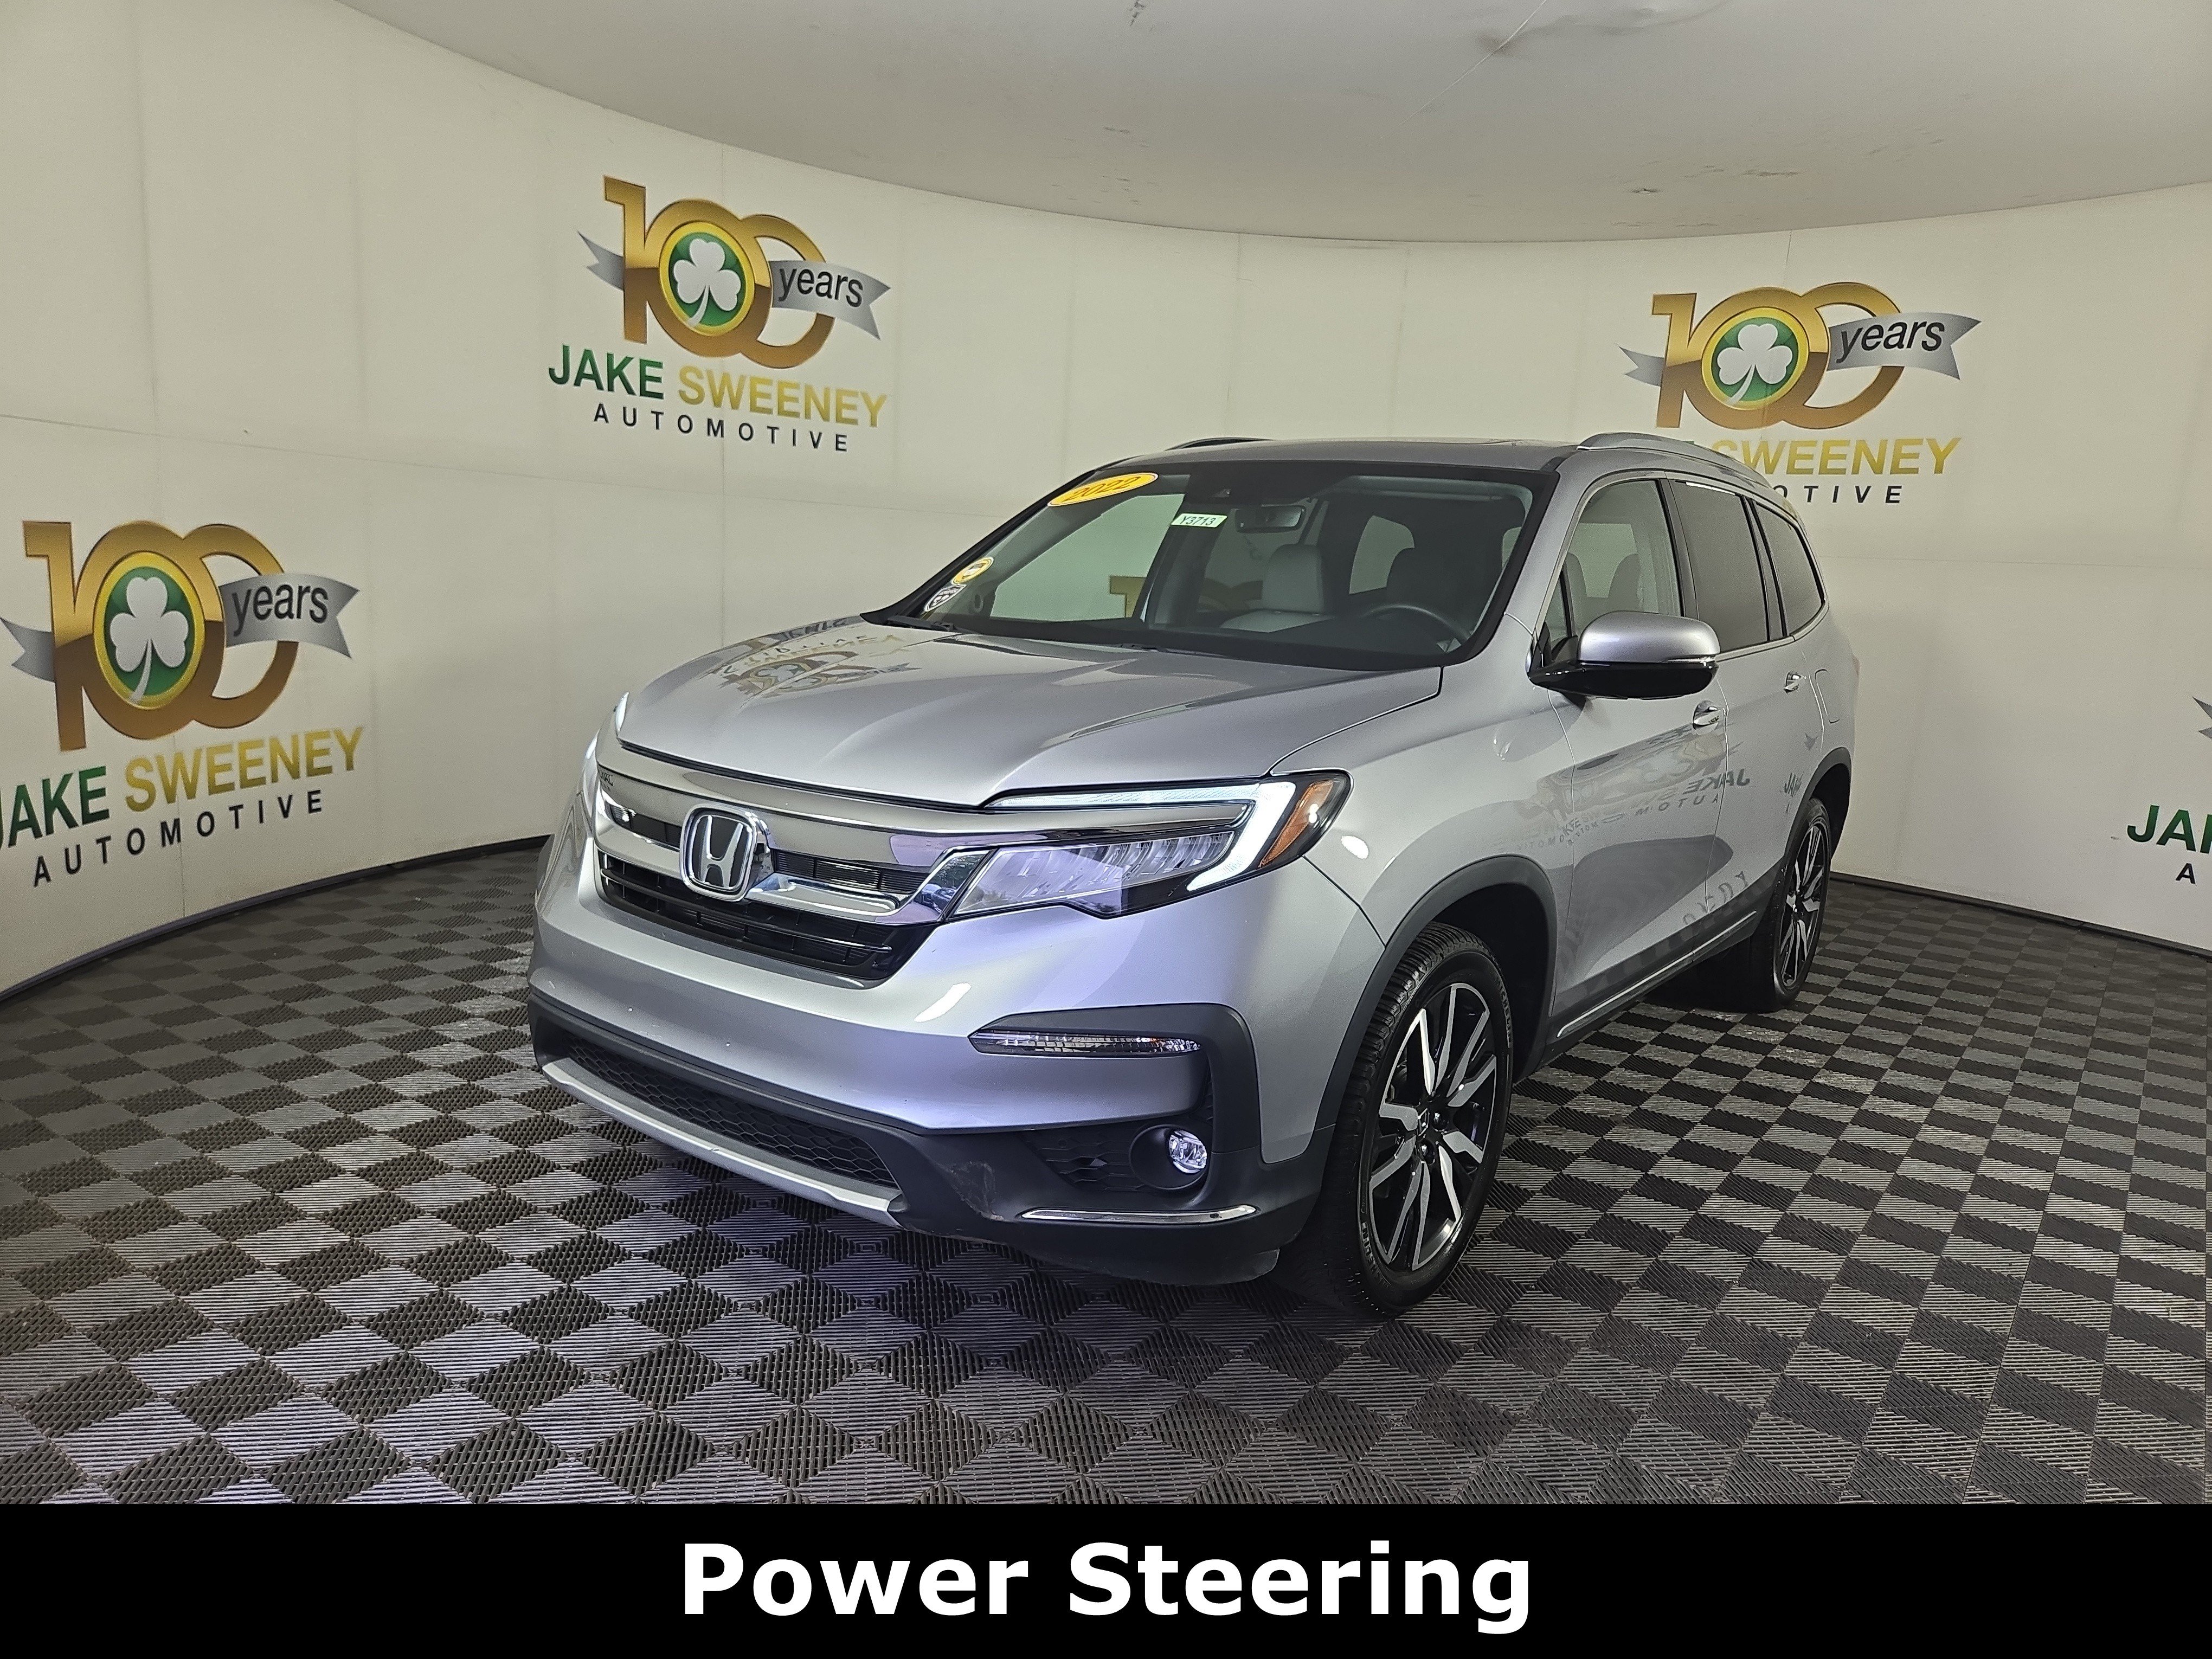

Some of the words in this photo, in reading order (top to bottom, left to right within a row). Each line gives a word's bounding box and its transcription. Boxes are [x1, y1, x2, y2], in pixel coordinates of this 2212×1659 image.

[603, 175, 835, 369] 100
[778, 267, 864, 308] years
[548, 344, 665, 400] JAKE
[678, 365, 888, 428] SWEENEY
[1651, 282, 1904, 430] 100
[1836, 320, 1945, 364] years
[594, 403, 848, 452] AUTOMOTIVE
[1060, 475, 1142, 504] 2022
[1179, 515, 1218, 526] Y3713
[23, 520, 299, 751] 100
[232, 583, 329, 637] years
[0, 766, 110, 849] AKE
[125, 726, 365, 812] SWEENEY
[33, 789, 323, 888] AUTOMOTIVE
